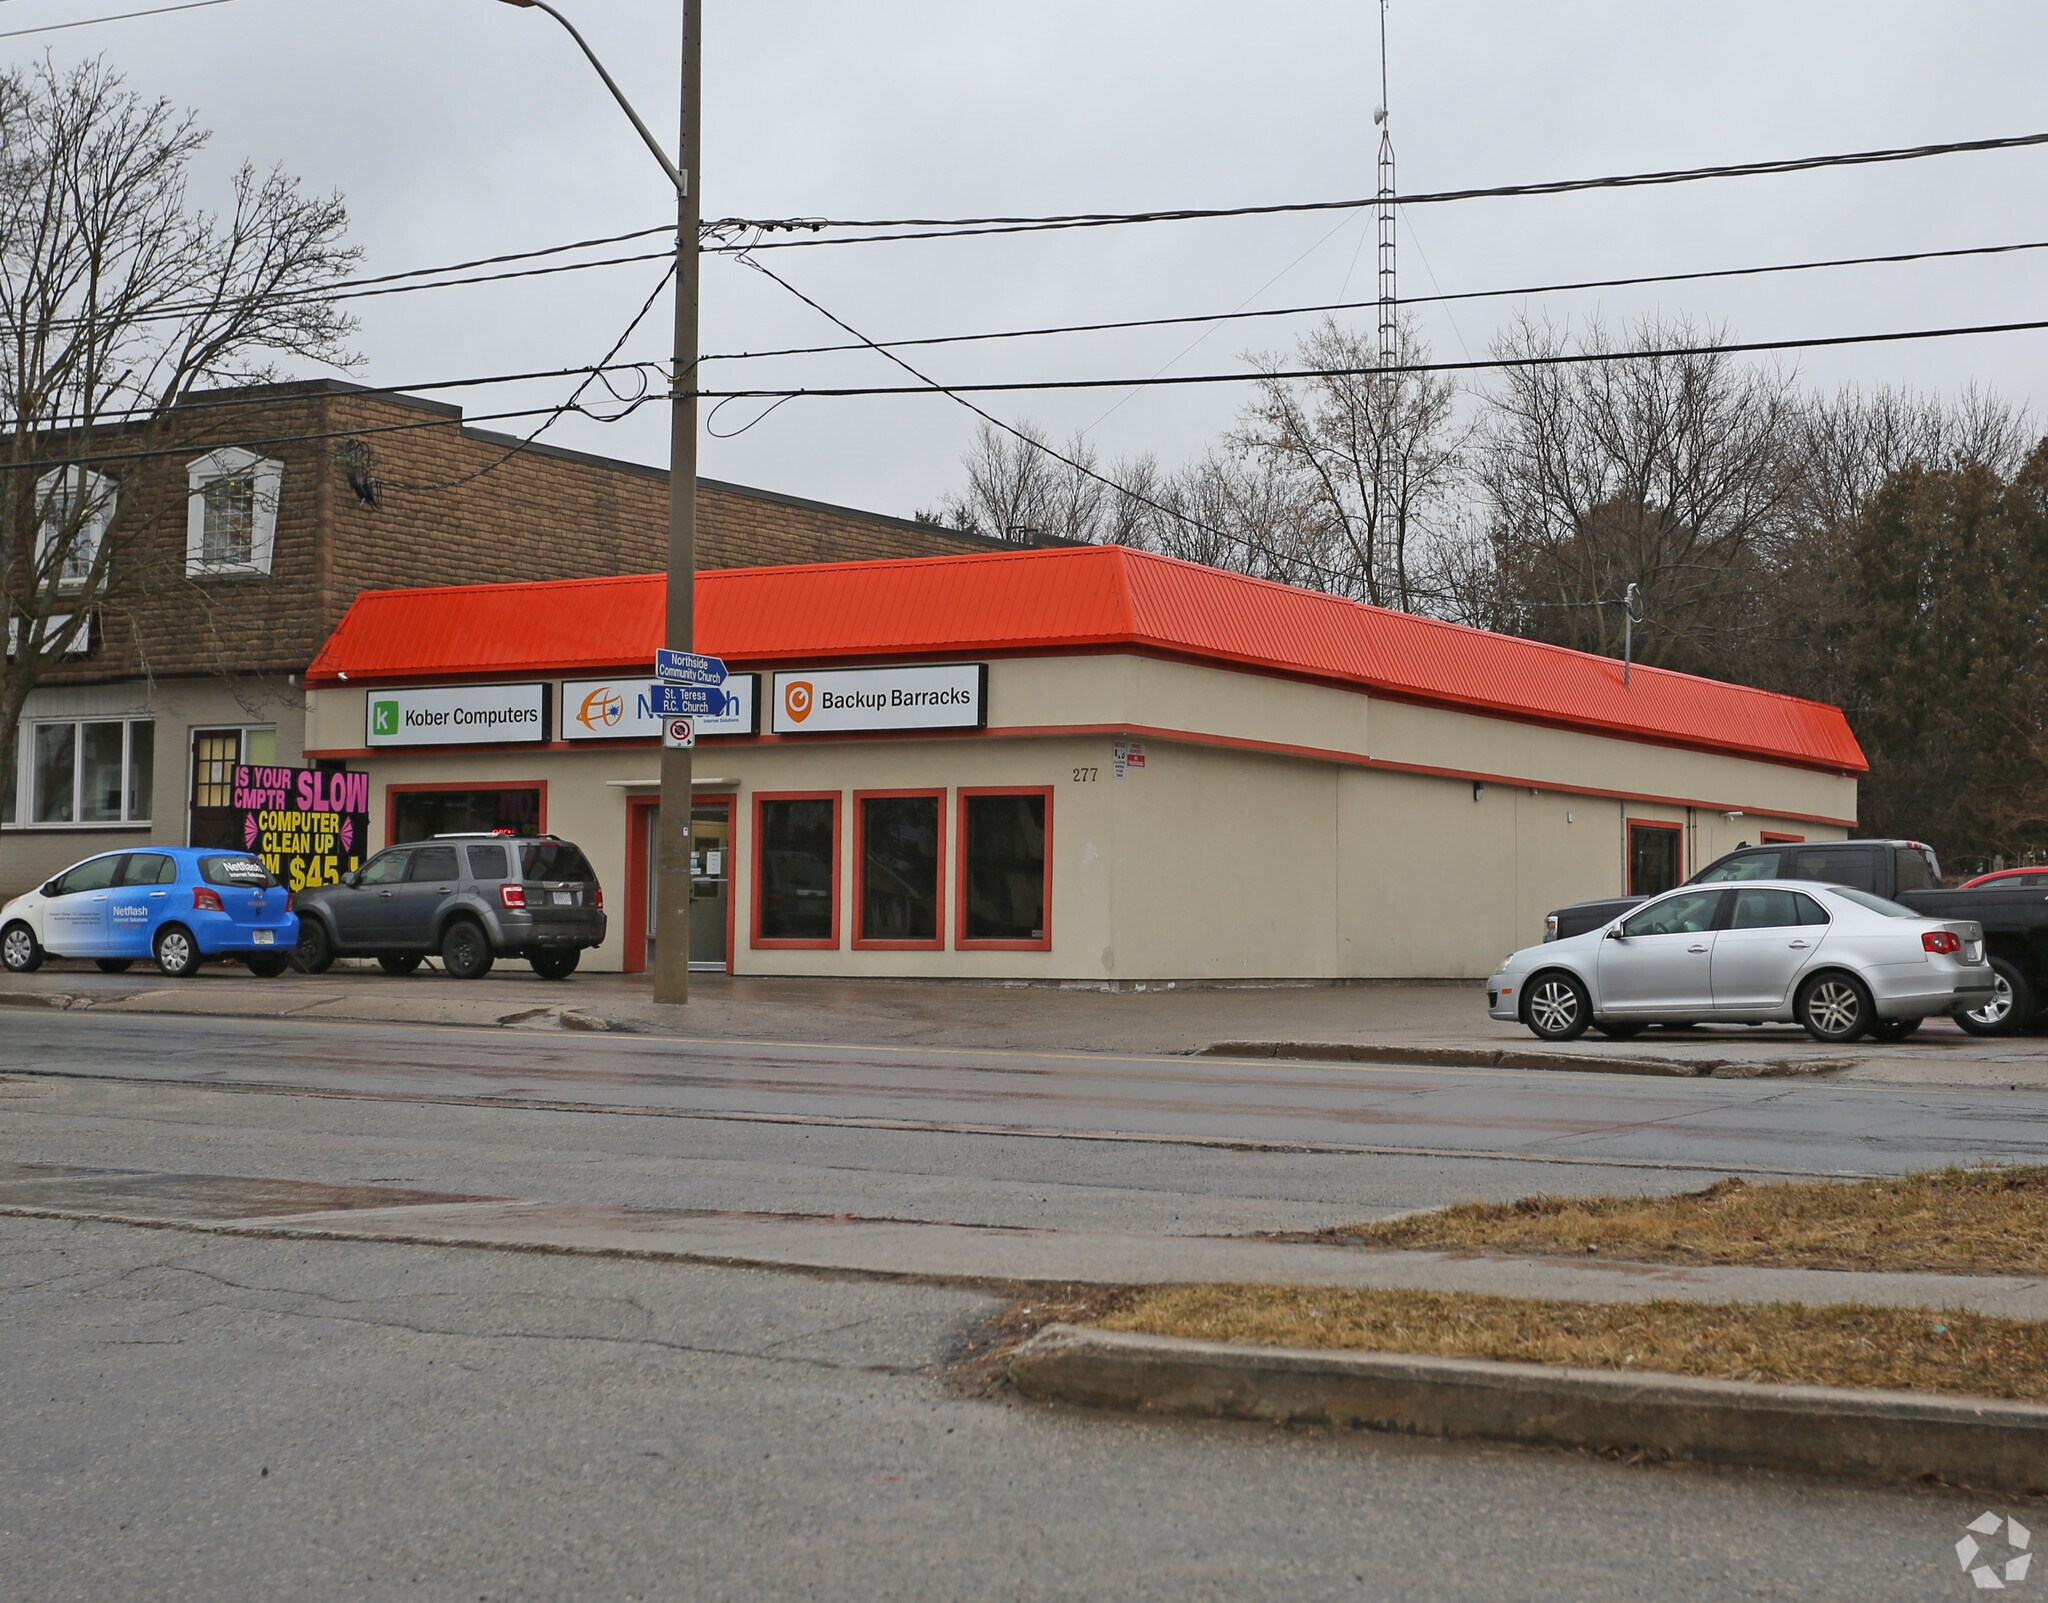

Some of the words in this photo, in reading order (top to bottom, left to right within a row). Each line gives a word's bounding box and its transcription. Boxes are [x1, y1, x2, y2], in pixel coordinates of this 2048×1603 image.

[671, 653, 709, 670] Northside
[659, 663, 697, 681] Community
[697, 670, 721, 684] Church
[664, 688, 676, 699] St.
[680, 689, 707, 701] Teresa
[822, 691, 887, 711] Backup
[891, 687, 971, 707] Barracks
[663, 700, 679, 711] R.C.
[682, 701, 708, 713] Church
[405, 709, 450, 727] Kober
[453, 707, 538, 728] Computers
[235, 766, 249, 787] IS
[254, 767, 292, 789] YOUR
[1073, 767, 1098, 782] 277
[234, 788, 285, 810] CMPTR
[297, 770, 368, 813] SLOW
[258, 810, 340, 833] COMPUTER
[262, 832, 310, 854] CLEAN
[315, 834, 335, 854] UP
[222, 861, 263, 873] Netflash
[113, 906, 148, 916] Netflash
